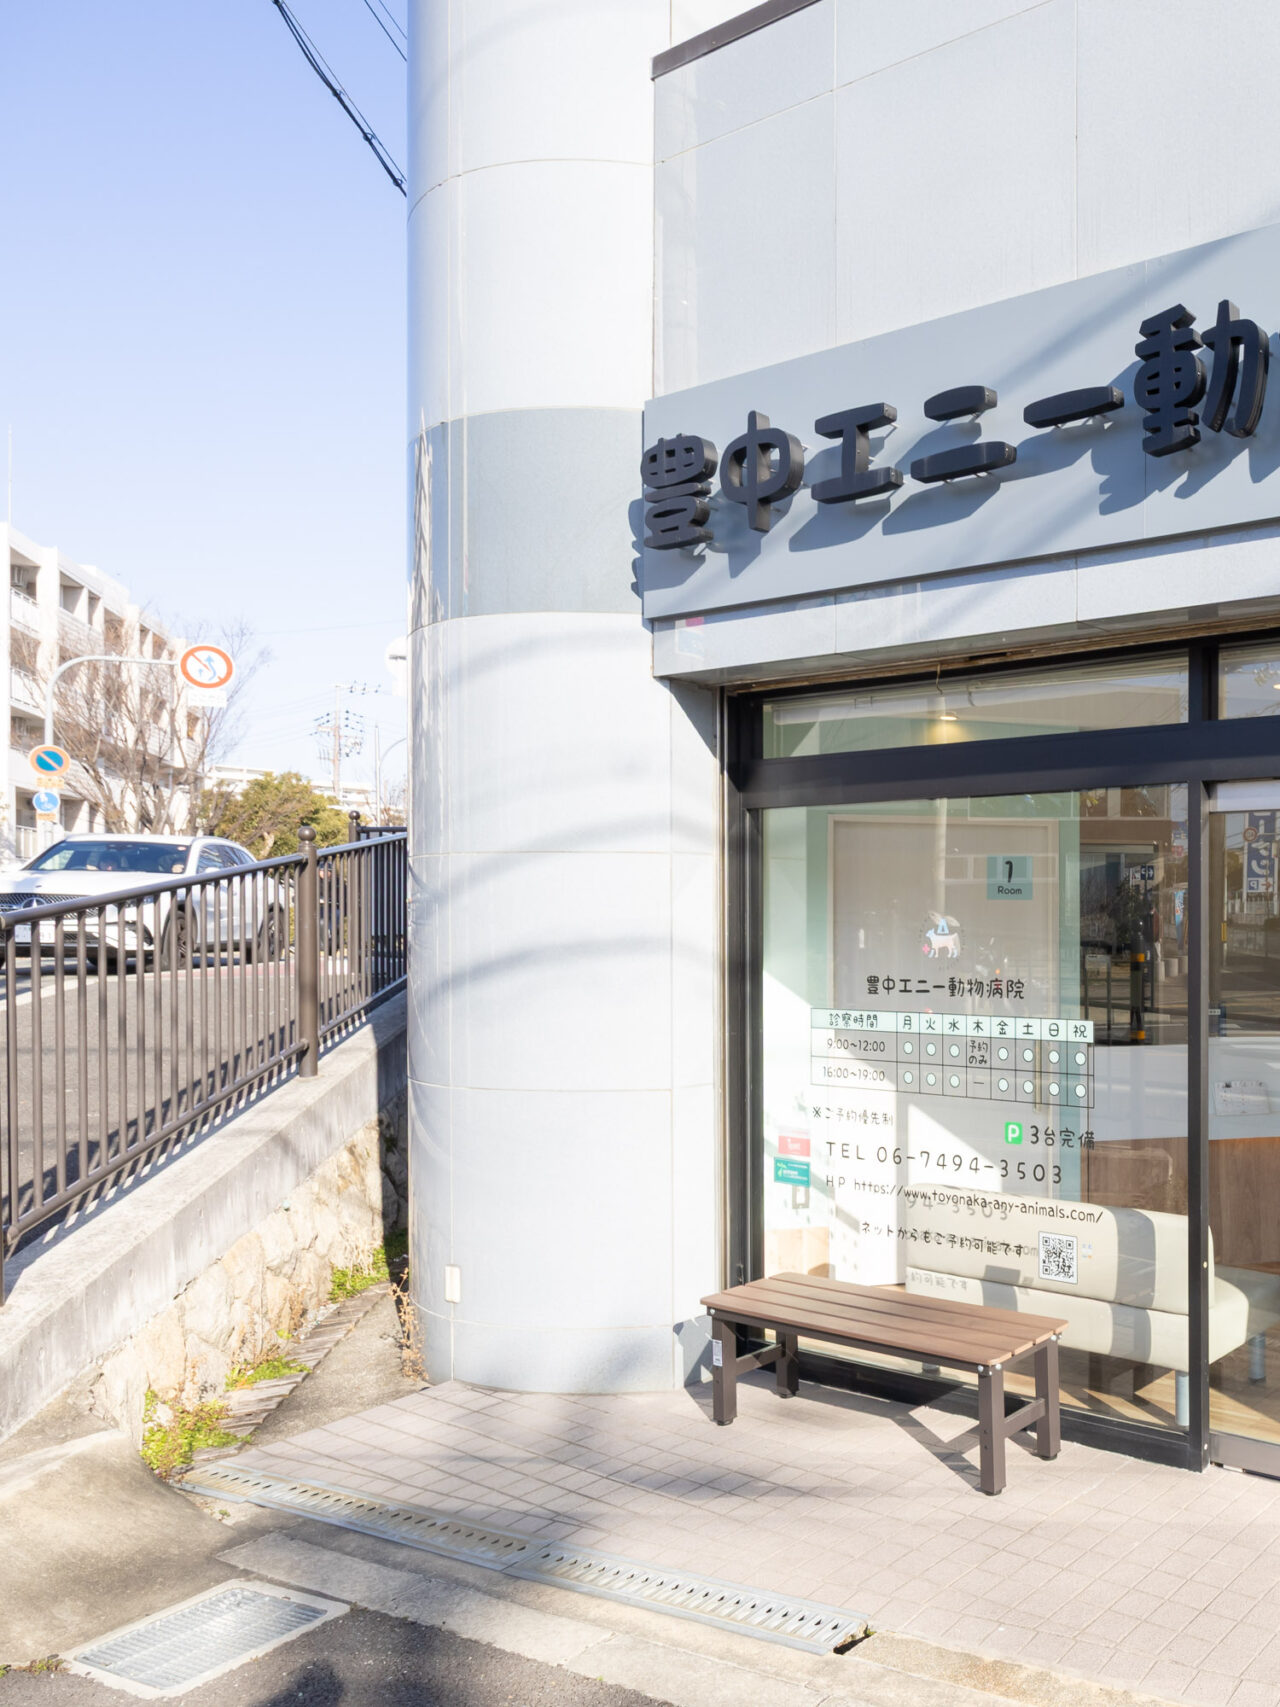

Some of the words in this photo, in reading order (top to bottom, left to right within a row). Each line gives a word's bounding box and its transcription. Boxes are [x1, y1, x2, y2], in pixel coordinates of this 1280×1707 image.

[1004, 860, 1013, 883] 1
[997, 885, 1022, 895] Room
[866, 975, 1025, 1000] 豊中エニー動物病院
[828, 1012, 879, 1029] 診察時間
[902, 1014, 912, 1030] 月
[925, 1016, 936, 1032] 火
[948, 1017, 960, 1033] 水
[972, 1018, 984, 1034] 木
[996, 1020, 1009, 1036] 金
[1022, 1021, 1034, 1036] 土
[1048, 1022, 1060, 1037] 日
[1072, 1023, 1088, 1039] 祝
[968, 1040, 989, 1054] 予約
[968, 1054, 988, 1065] のみ
[1029, 1124, 1096, 1151] 3台完備
[826, 1141, 865, 1161] TEL
[876, 1146, 1063, 1185] 06-7494-3503
[825, 1175, 846, 1190] HP
[854, 1178, 1104, 1224] https://www.toyonaka-any-animals.com/
[861, 1221, 1024, 1258] ネットからもご予約可能です
